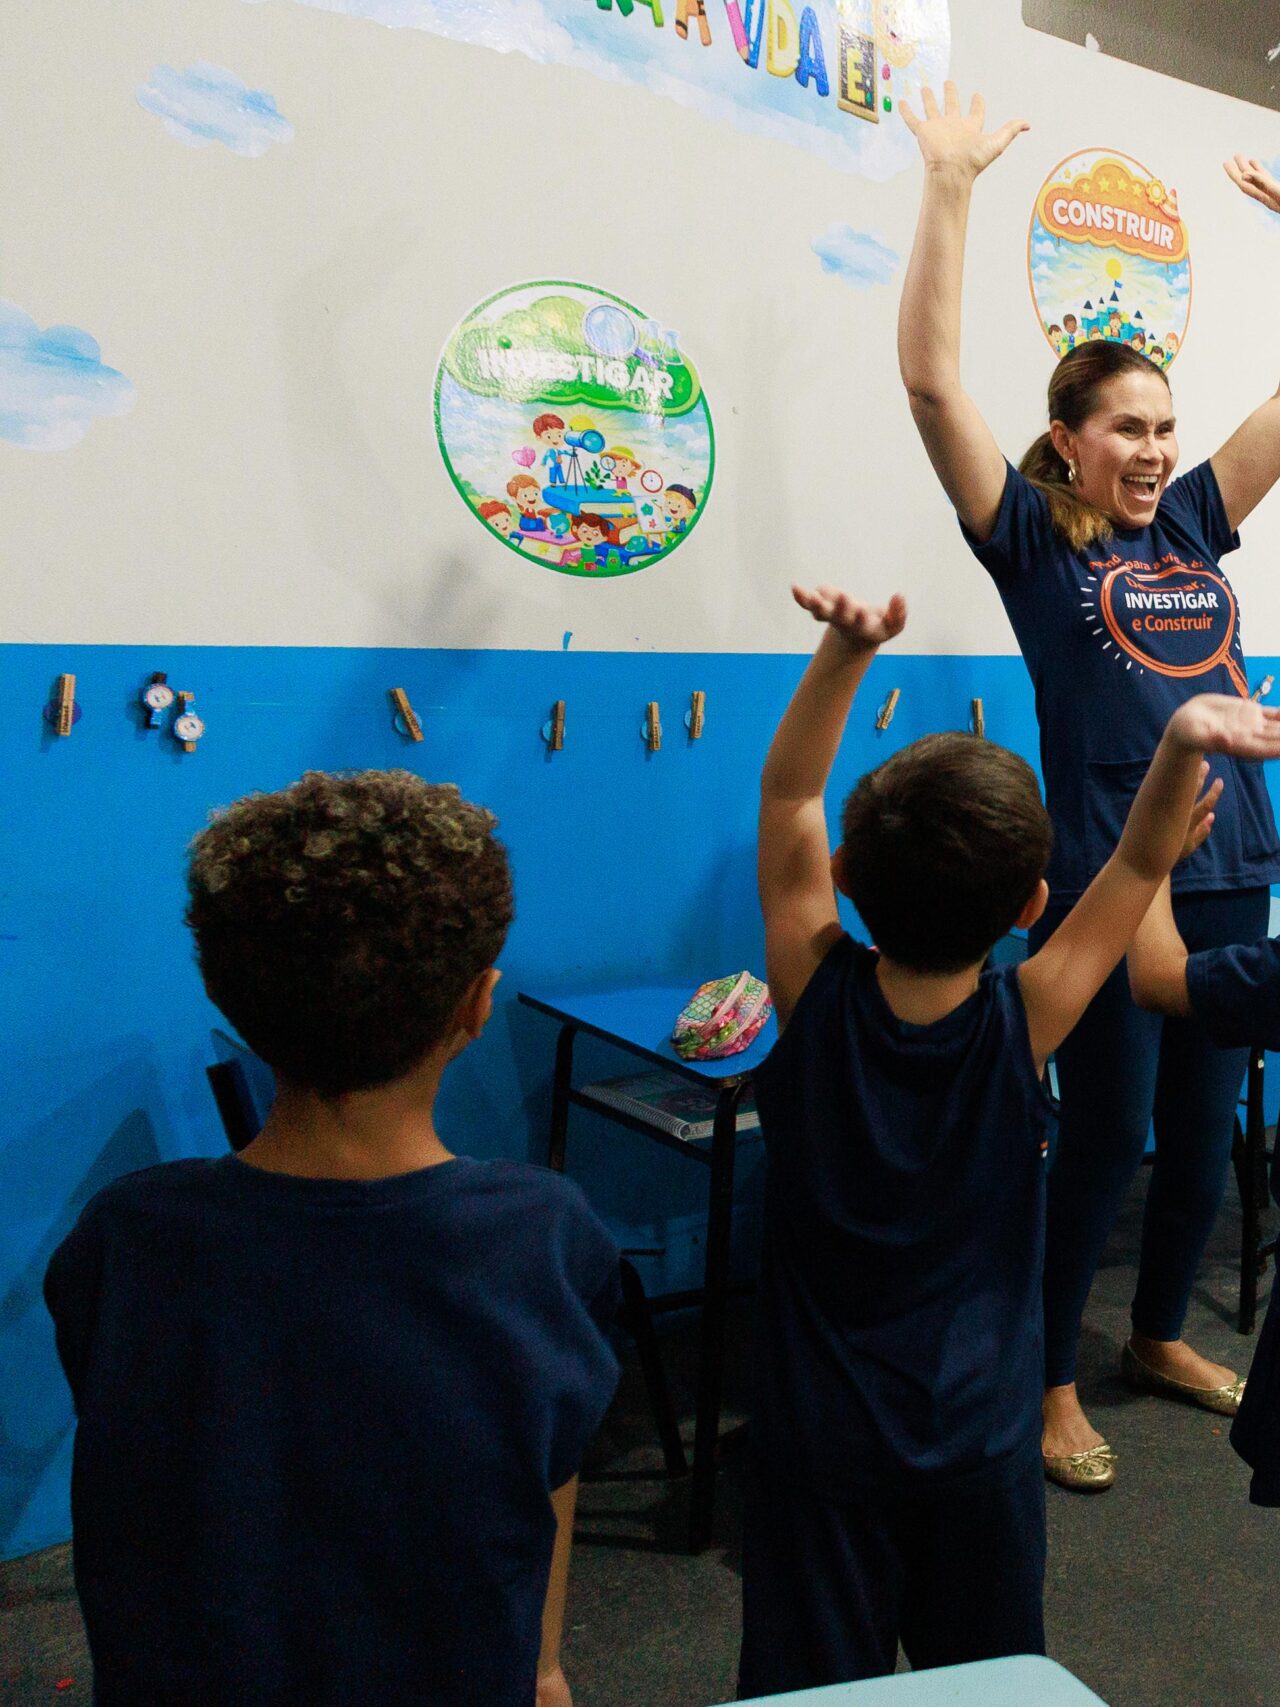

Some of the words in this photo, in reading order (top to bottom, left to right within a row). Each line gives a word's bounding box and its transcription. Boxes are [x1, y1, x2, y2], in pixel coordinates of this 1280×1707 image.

[1052, 198, 1174, 250] CONSTRUIR
[478, 348, 674, 399] INSTIGAR
[1124, 591, 1219, 610] INVESTIGAR
[1132, 617, 1142, 632] e
[1144, 613, 1214, 632] Construir
